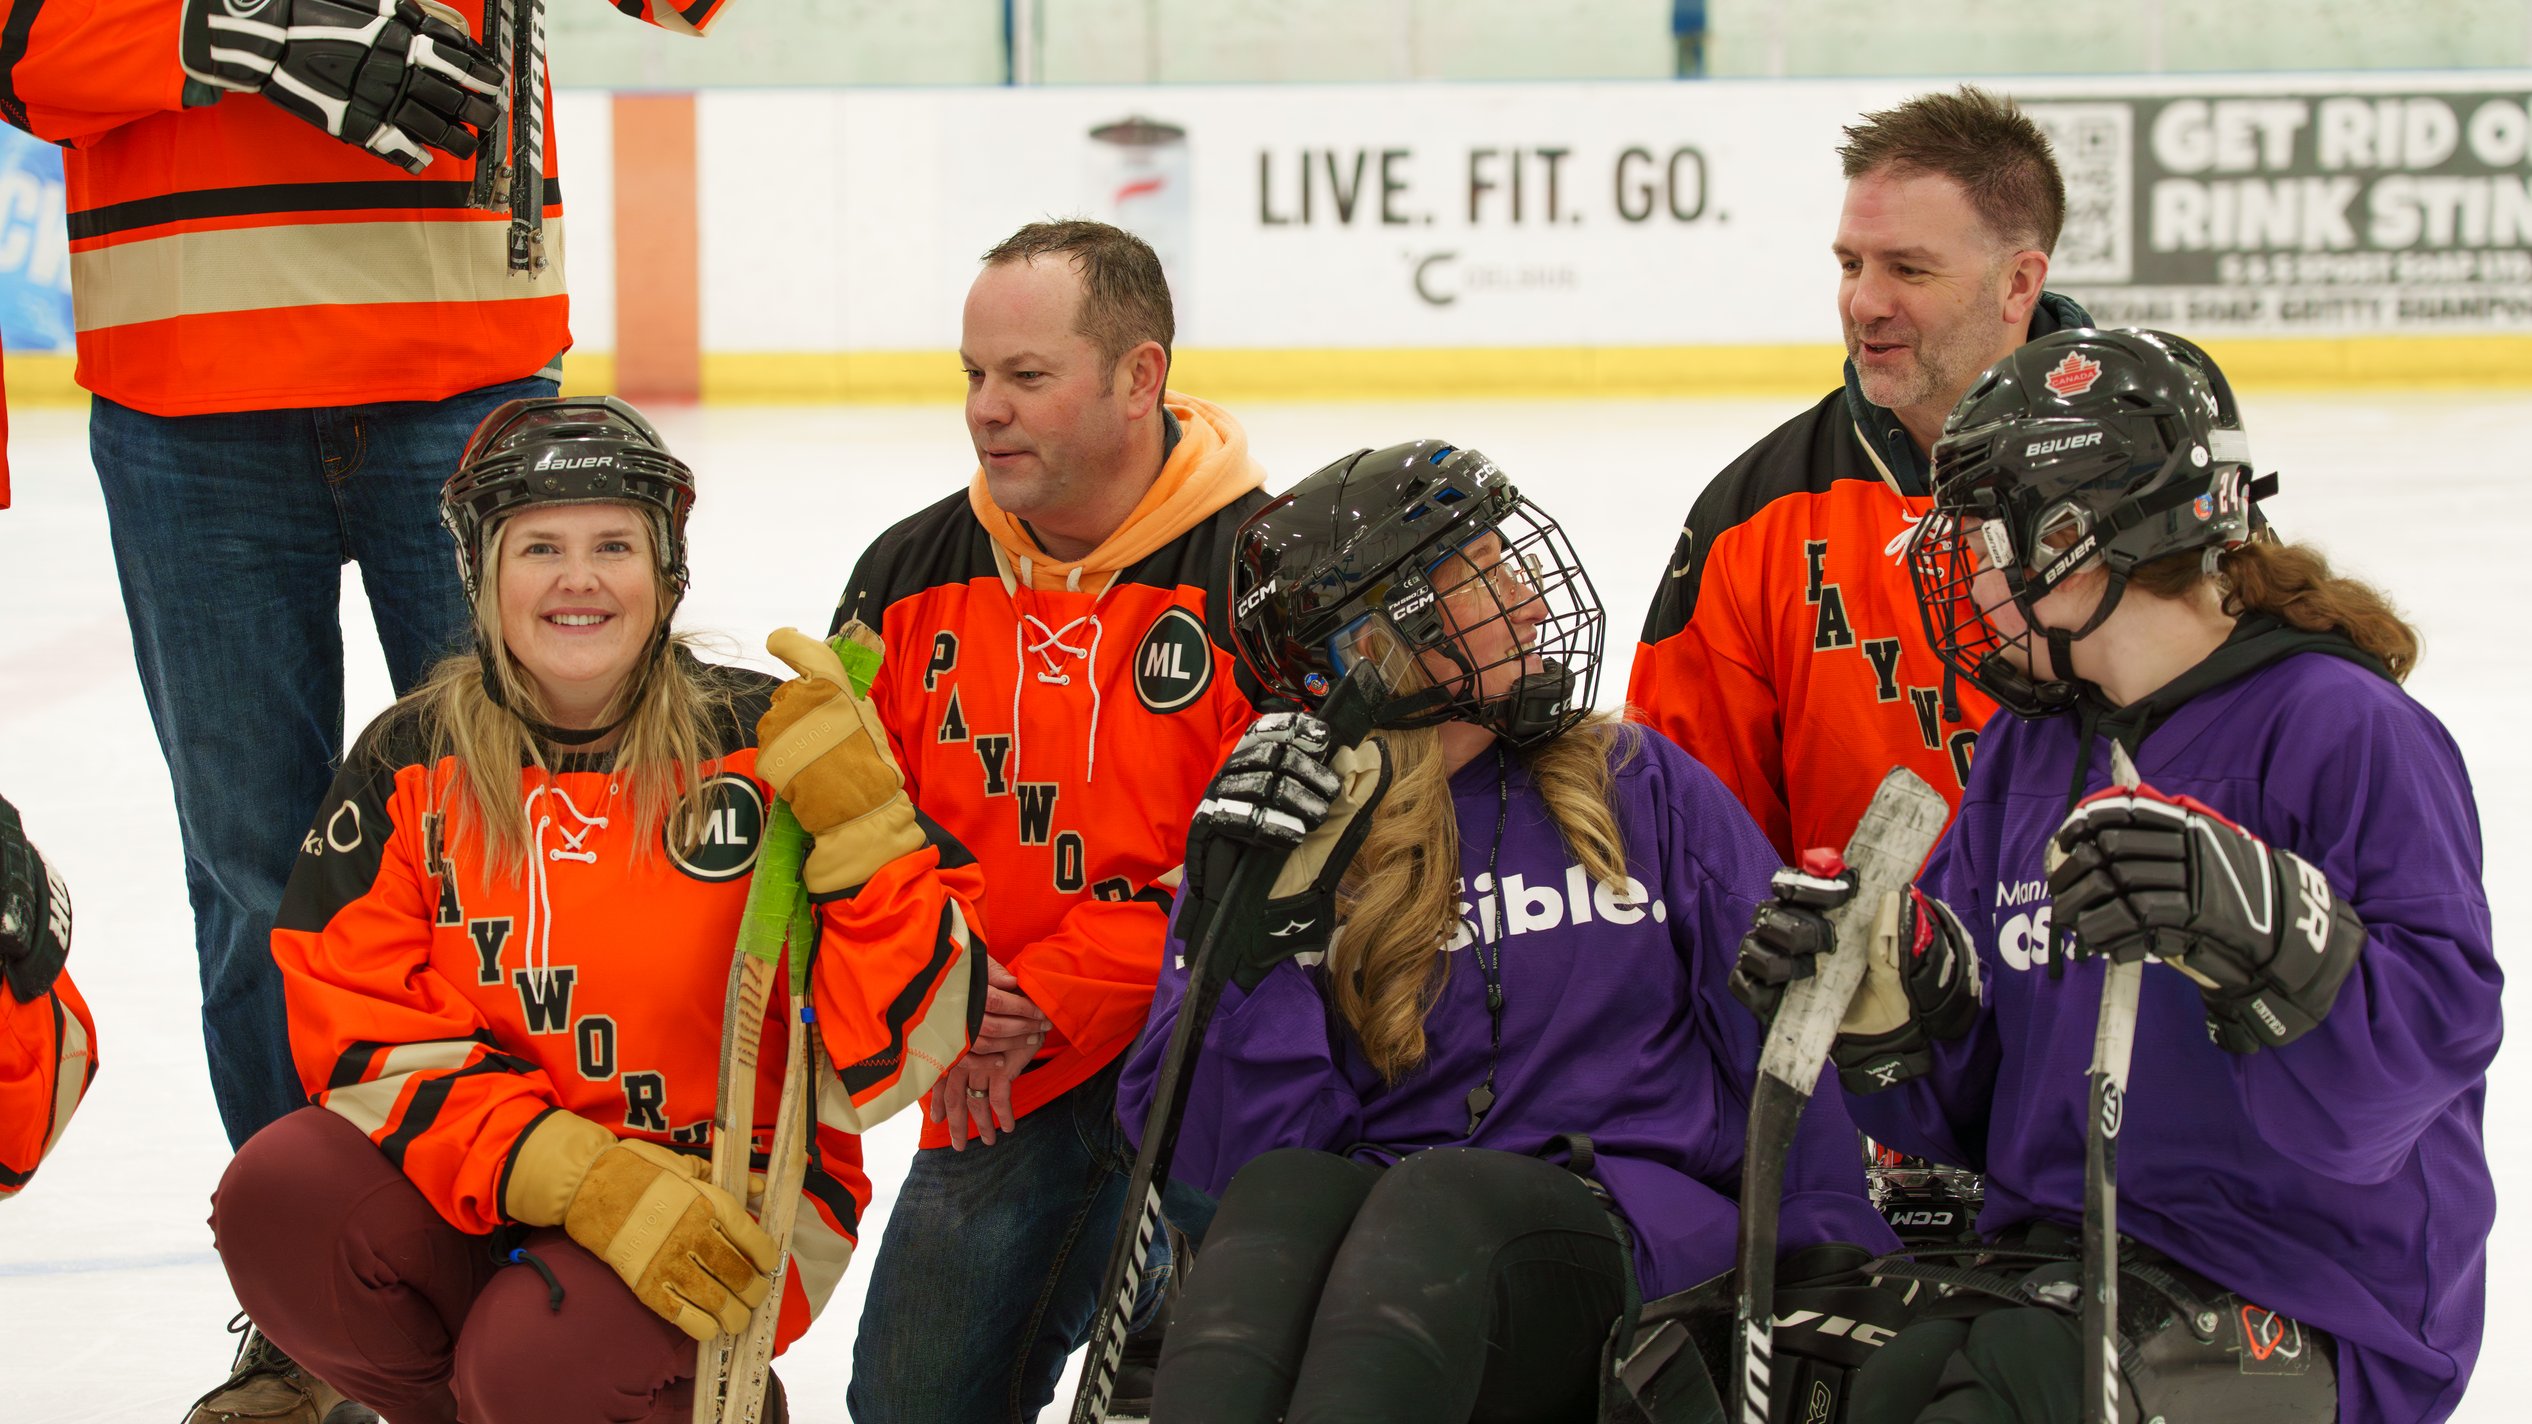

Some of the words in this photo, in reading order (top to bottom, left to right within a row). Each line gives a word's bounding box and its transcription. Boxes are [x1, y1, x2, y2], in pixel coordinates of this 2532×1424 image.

[2152, 97, 2310, 173] GET
[2317, 96, 2460, 170] RID
[2469, 97, 2532, 167] O
[1257, 148, 1434, 226] LIVE.
[1467, 149, 1581, 226] FIT.
[1613, 145, 1732, 225] GO.
[2150, 175, 2361, 252] RINK
[2051, 370, 2097, 388] CANADA
[2026, 431, 2103, 458] BAUER
[534, 457, 613, 472] BAUER
[2044, 534, 2097, 584] BAUER
[1238, 579, 1277, 619] CCM
[1393, 592, 1435, 621] CCM
[1145, 642, 1191, 681] ML
[767, 721, 832, 780] BURTON
[685, 808, 748, 847] ML
[2252, 998, 2287, 1036] UNITED
[1889, 1210, 1954, 1226] CCM
